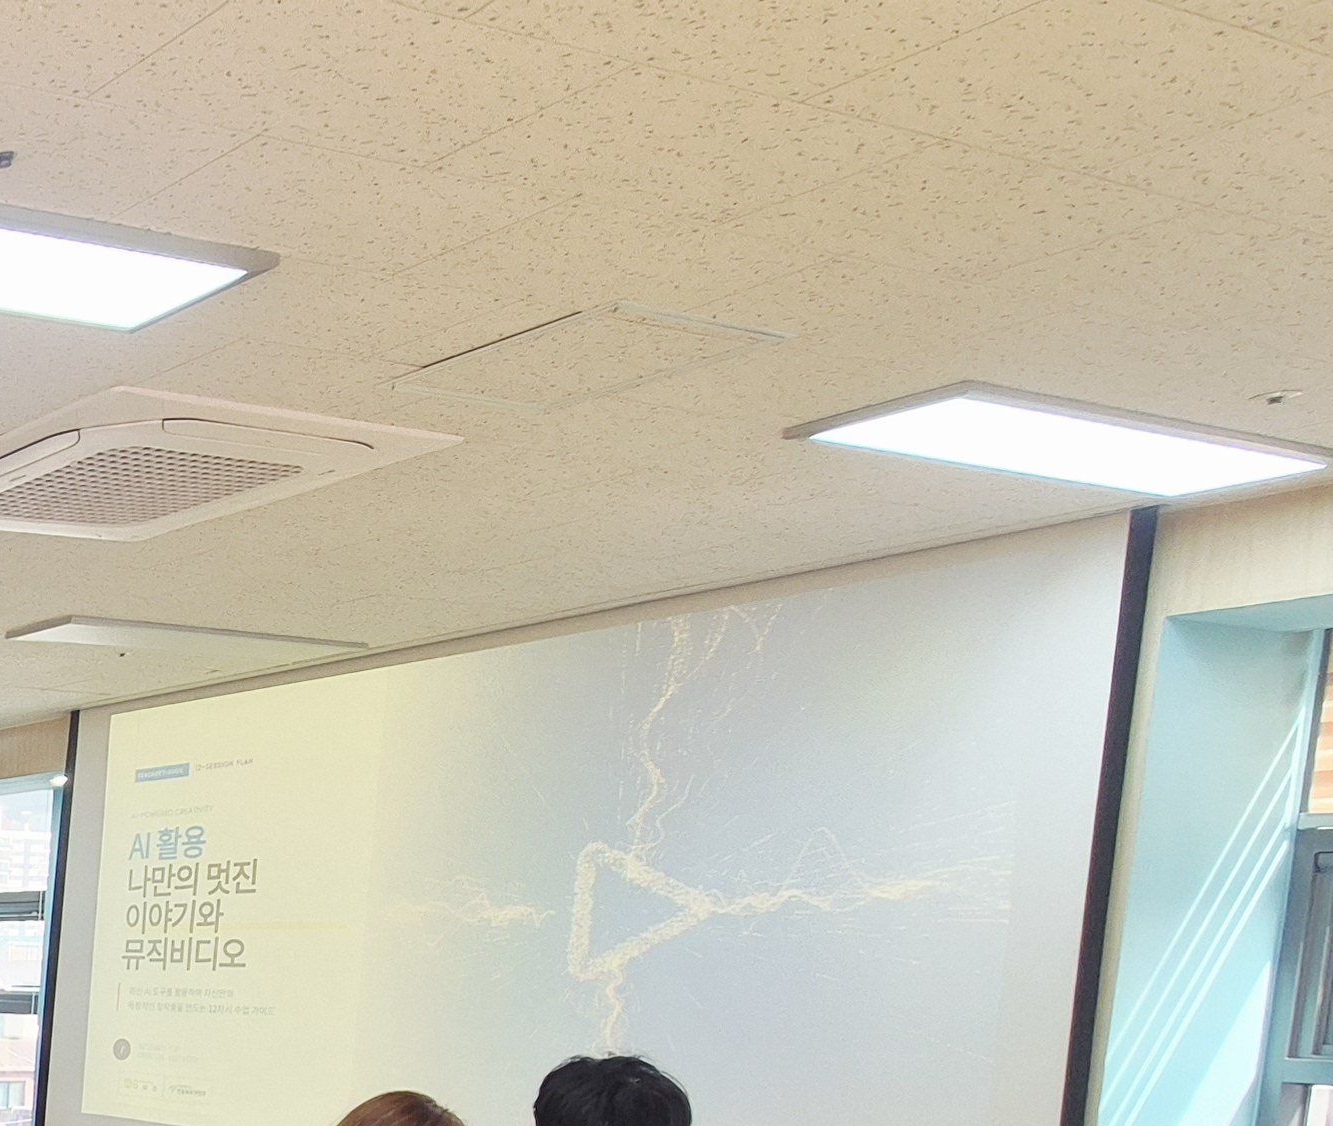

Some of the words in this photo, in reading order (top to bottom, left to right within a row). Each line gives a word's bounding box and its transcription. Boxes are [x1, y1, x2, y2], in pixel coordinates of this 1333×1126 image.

[129, 832, 151, 861] AI
[156, 826, 207, 860] 활용
[128, 862, 199, 898] 나만의
[206, 858, 258, 895] 멋진
[126, 899, 224, 934] 이야기와
[122, 936, 246, 971] 뮤직비디오
[251, 1005, 275, 1017] 가이드
